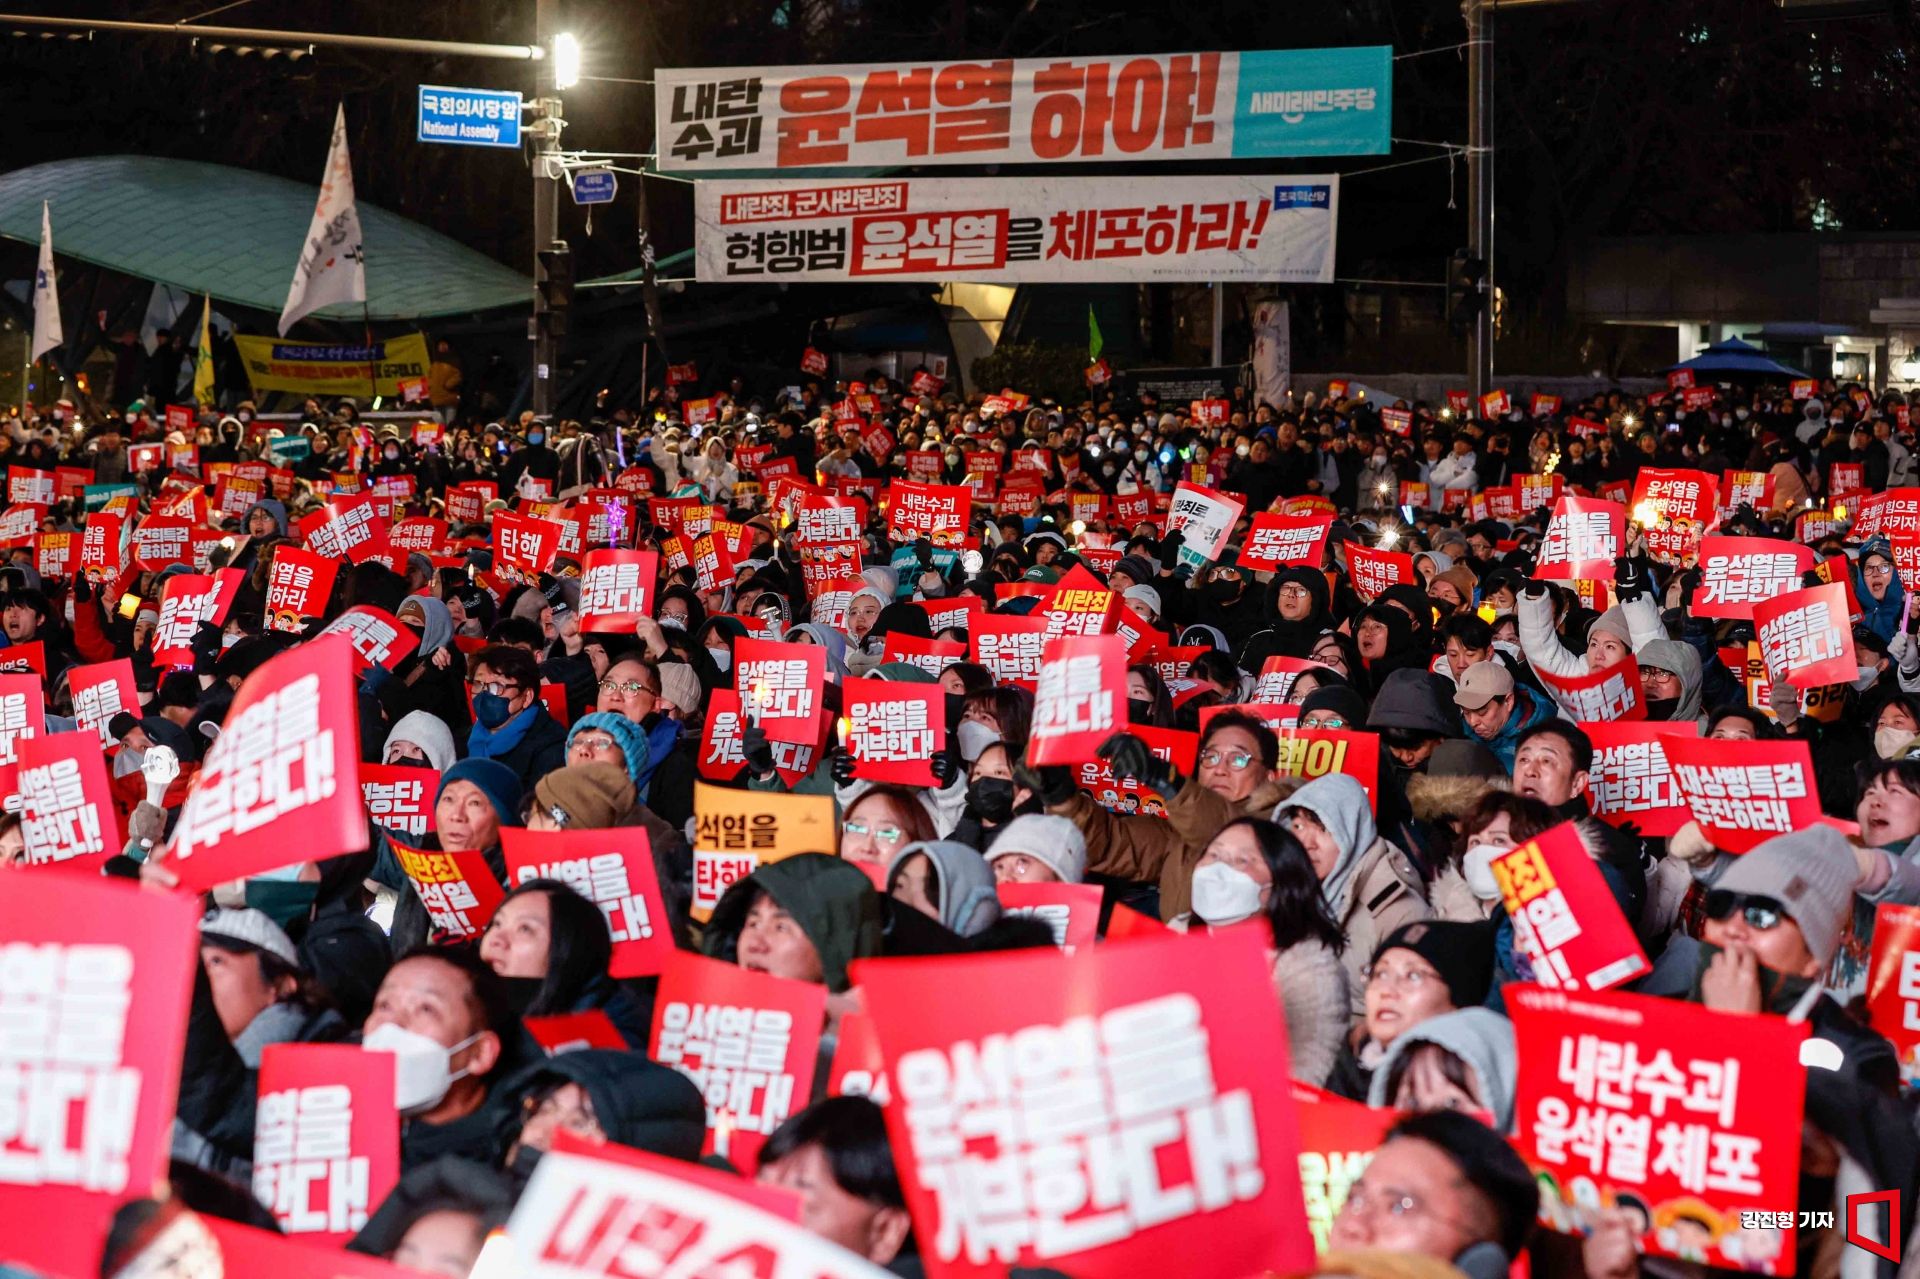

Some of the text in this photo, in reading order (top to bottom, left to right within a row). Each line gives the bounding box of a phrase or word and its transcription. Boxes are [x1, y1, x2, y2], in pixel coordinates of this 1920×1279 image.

[423, 94, 518, 121] 국회의사당앞
[672, 76, 764, 125] 내란
[777, 51, 1221, 168] 윤석열 하야!
[1250, 87, 1377, 124] 새미래민주당
[423, 120, 500, 142] National Assembly
[672, 115, 764, 162] 수괴
[726, 185, 904, 221] 내란죄, 군사반란죄
[726, 227, 846, 277] 현행범
[1046, 199, 1272, 262] 체포하라!
[902, 493, 955, 513] 내란수괴
[1647, 480, 1700, 500] 윤석열을
[894, 508, 931, 529] 윤석열
[1118, 499, 1149, 520] 탄핵
[1882, 515, 1917, 531] 지키자
[1885, 499, 1918, 516] 힘으로
[501, 528, 542, 568] 탄핵
[1247, 543, 1311, 561] 수용하라!
[1253, 525, 1325, 545] 김건희특검
[1354, 555, 1400, 582] 윤석열을
[1705, 553, 1798, 580] 윤석열을
[1053, 589, 1113, 612] 내란죄
[1047, 610, 1105, 636] 윤석열
[739, 660, 809, 690] 윤석열을
[851, 699, 928, 733] 윤석열을
[852, 729, 935, 763] 거부한다!
[1589, 741, 1673, 783] 윤석열을
[1674, 761, 1806, 800] 채상병특검
[1688, 798, 1793, 833] 추진하라!
[657, 1002, 793, 1071] 윤석열을
[897, 992, 1215, 1164] 윤석열을
[1557, 1034, 1741, 1127] 내란수괴
[1533, 1095, 1764, 1197] 윤석열 체포
[918, 1089, 1266, 1264] 거부한다!
